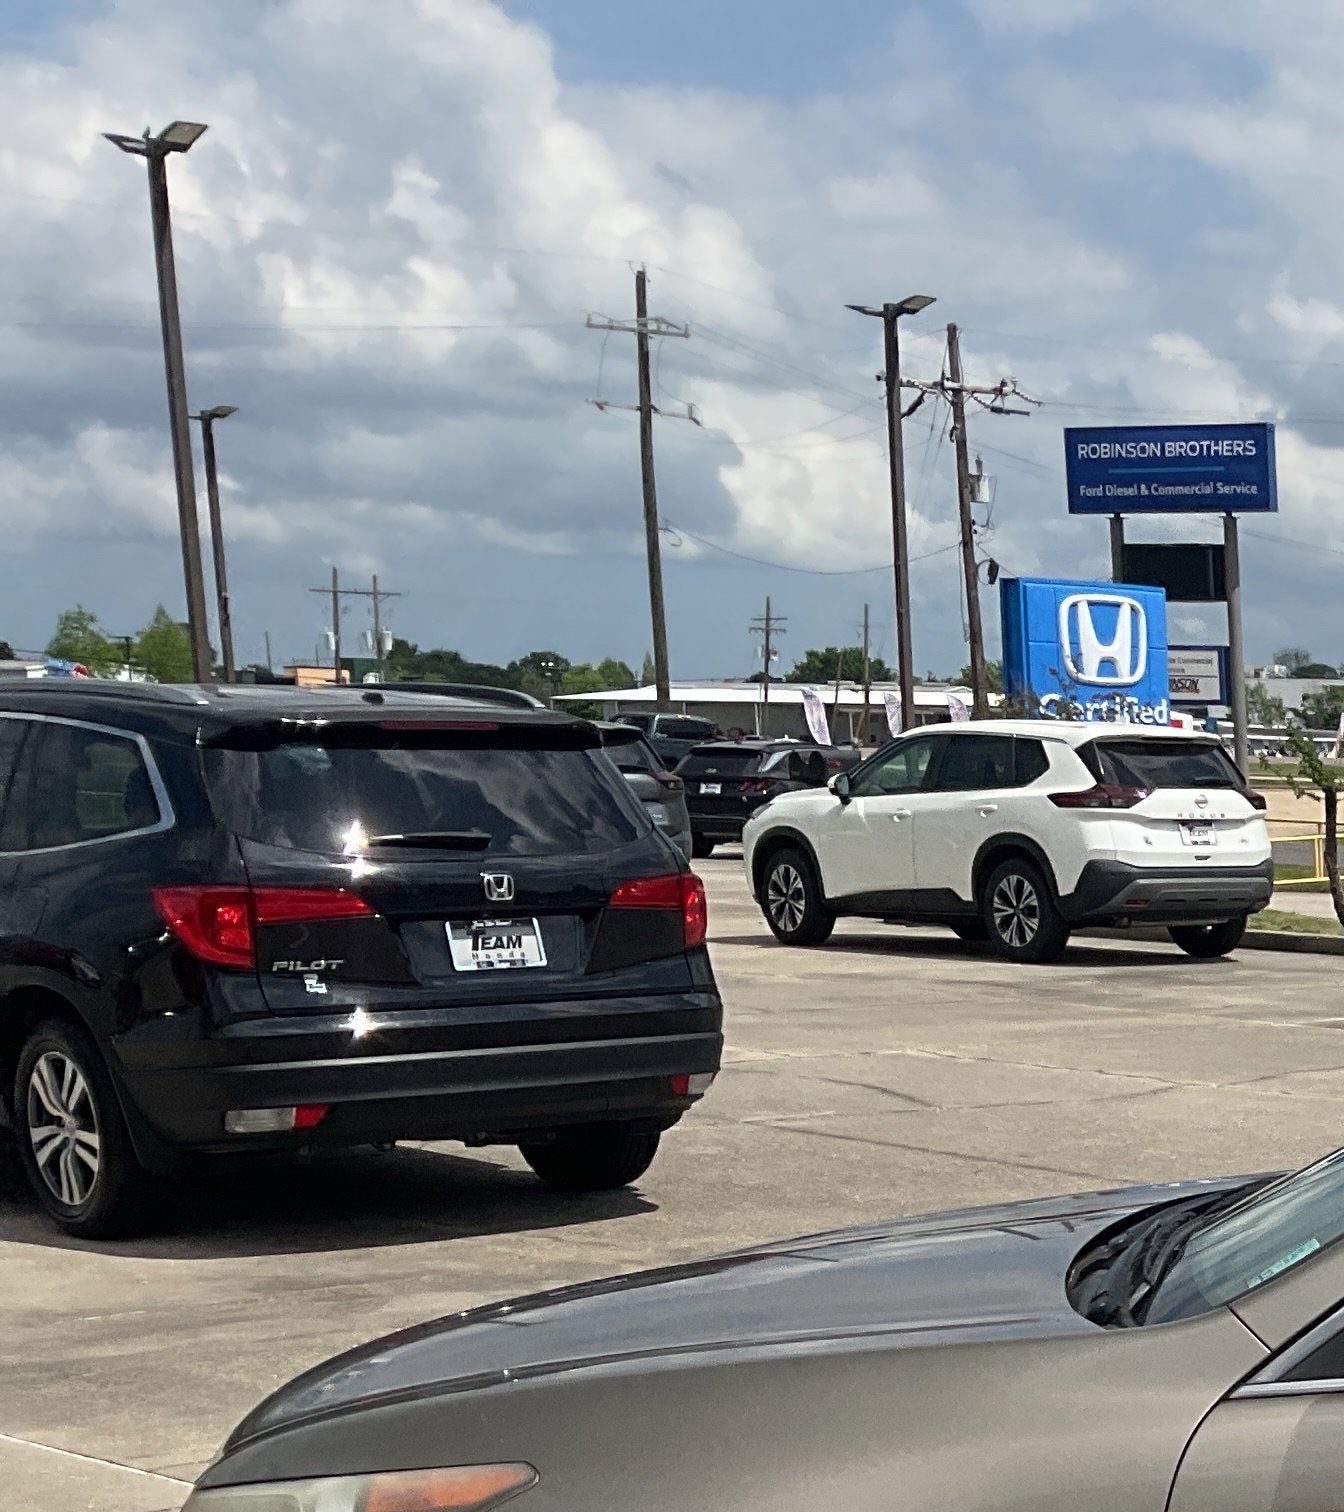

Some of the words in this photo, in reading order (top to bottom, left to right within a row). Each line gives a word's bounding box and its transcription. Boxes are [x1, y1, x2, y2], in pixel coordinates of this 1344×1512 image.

[1077, 442, 1161, 459] ROBINSON
[1164, 440, 1257, 458] BROTHERS
[1080, 484, 1102, 497] Ford
[1105, 484, 1138, 497] Diesel
[1140, 484, 1149, 495] &
[1151, 481, 1214, 495] Commercial
[1216, 482, 1258, 495] Service
[466, 929, 523, 952] TEAM
[271, 959, 345, 972] PILOT
